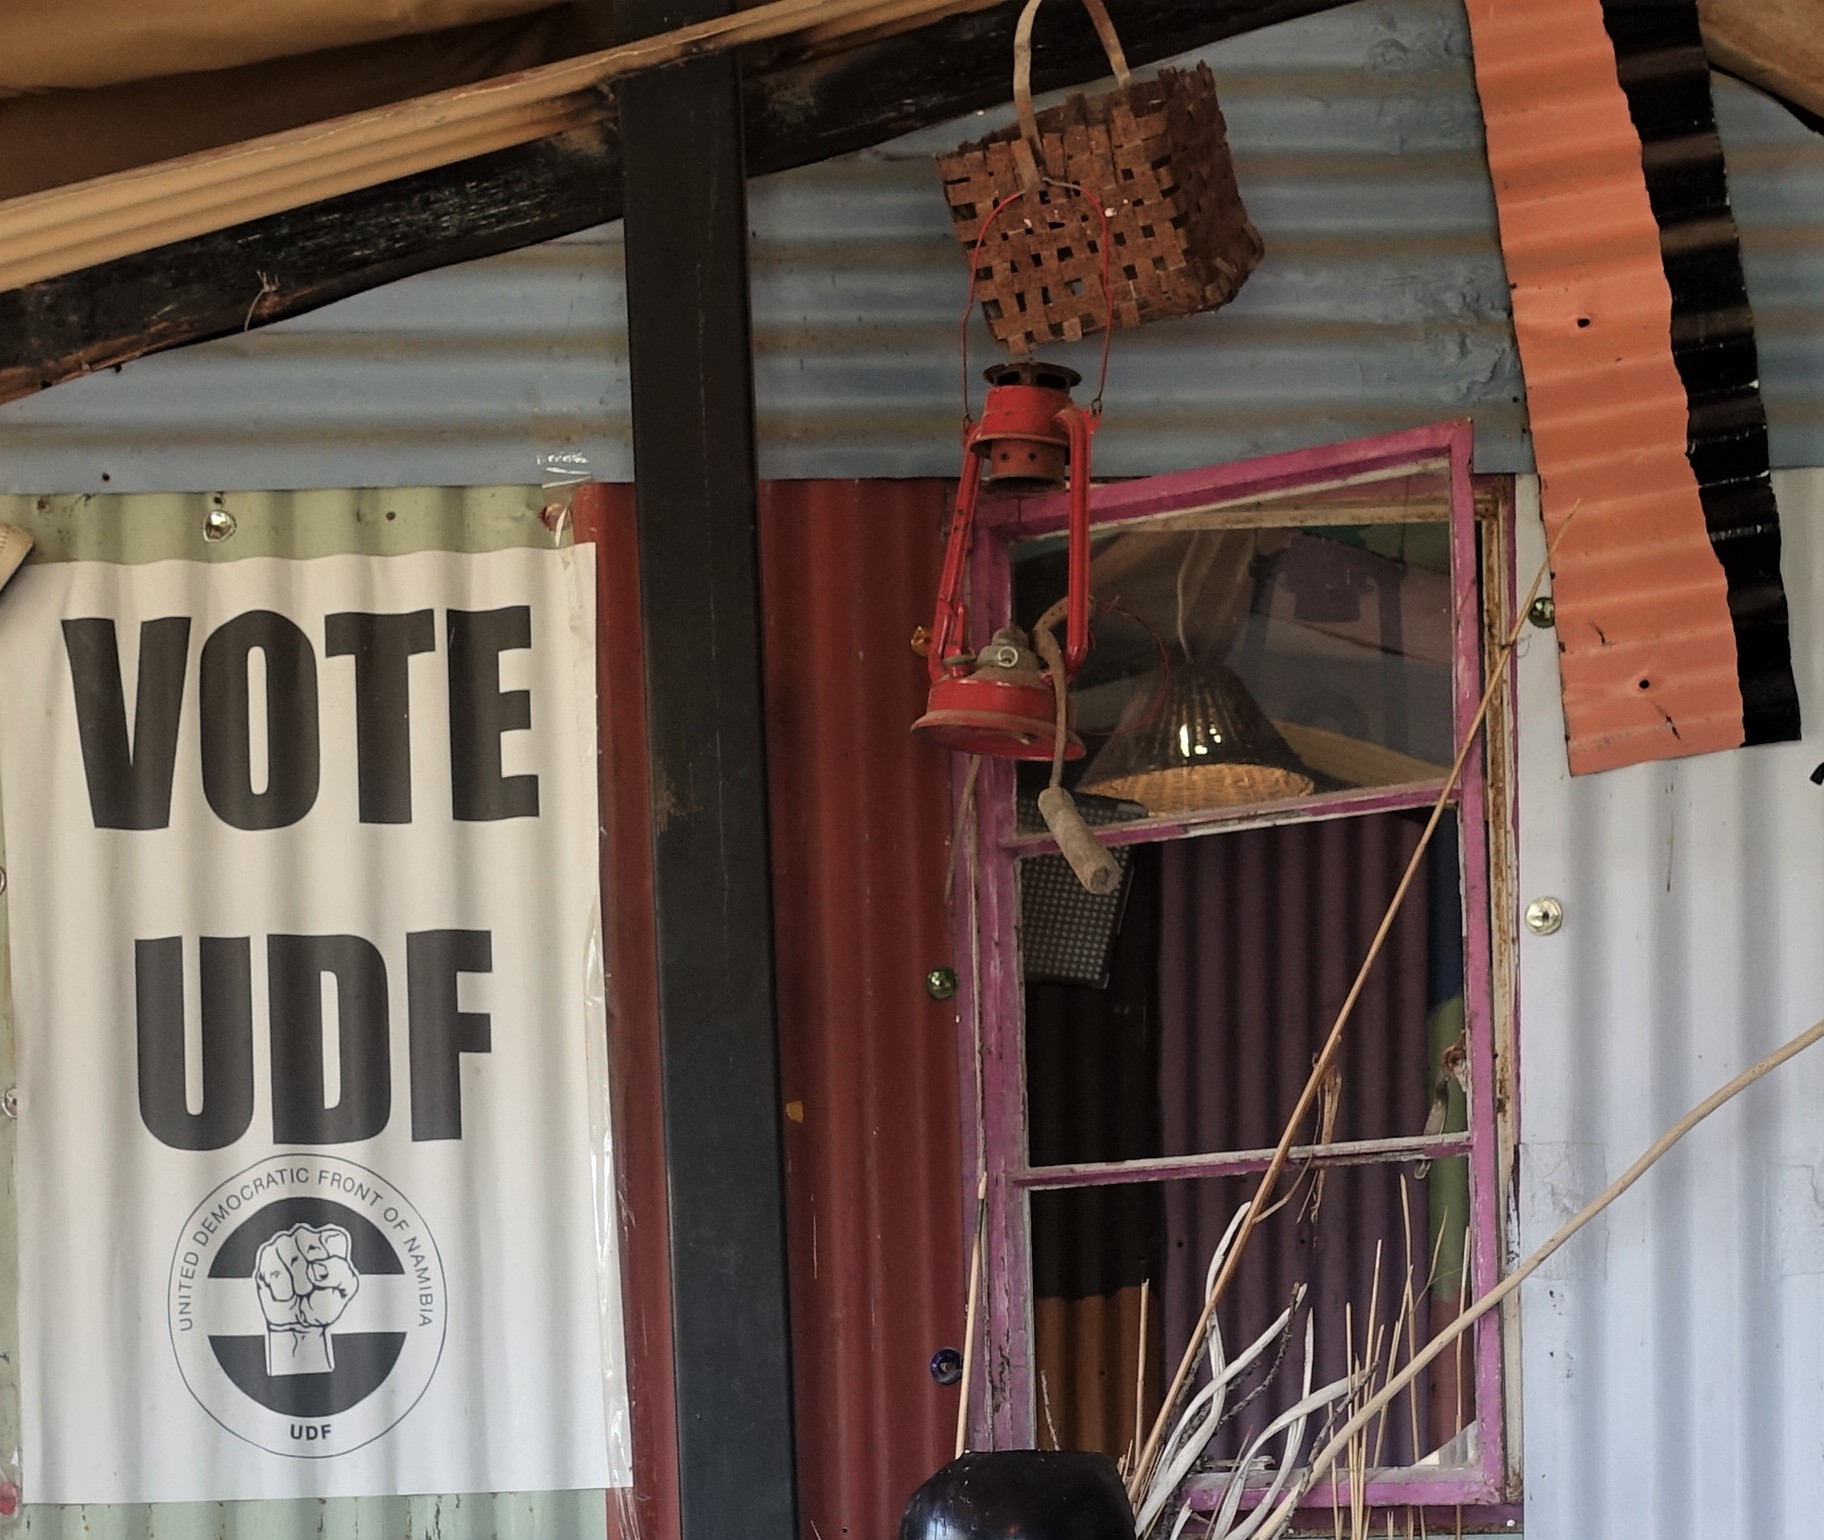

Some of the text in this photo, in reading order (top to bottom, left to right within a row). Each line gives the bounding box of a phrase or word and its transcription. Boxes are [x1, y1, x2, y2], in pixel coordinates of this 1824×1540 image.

[61, 605, 540, 830] VOTE
[134, 928, 492, 1150] UDF
[177, 1167, 433, 1332] UNITED DEMOCRATIC FRONT OF NAMIBIA
[290, 1424, 332, 1441] UDF
